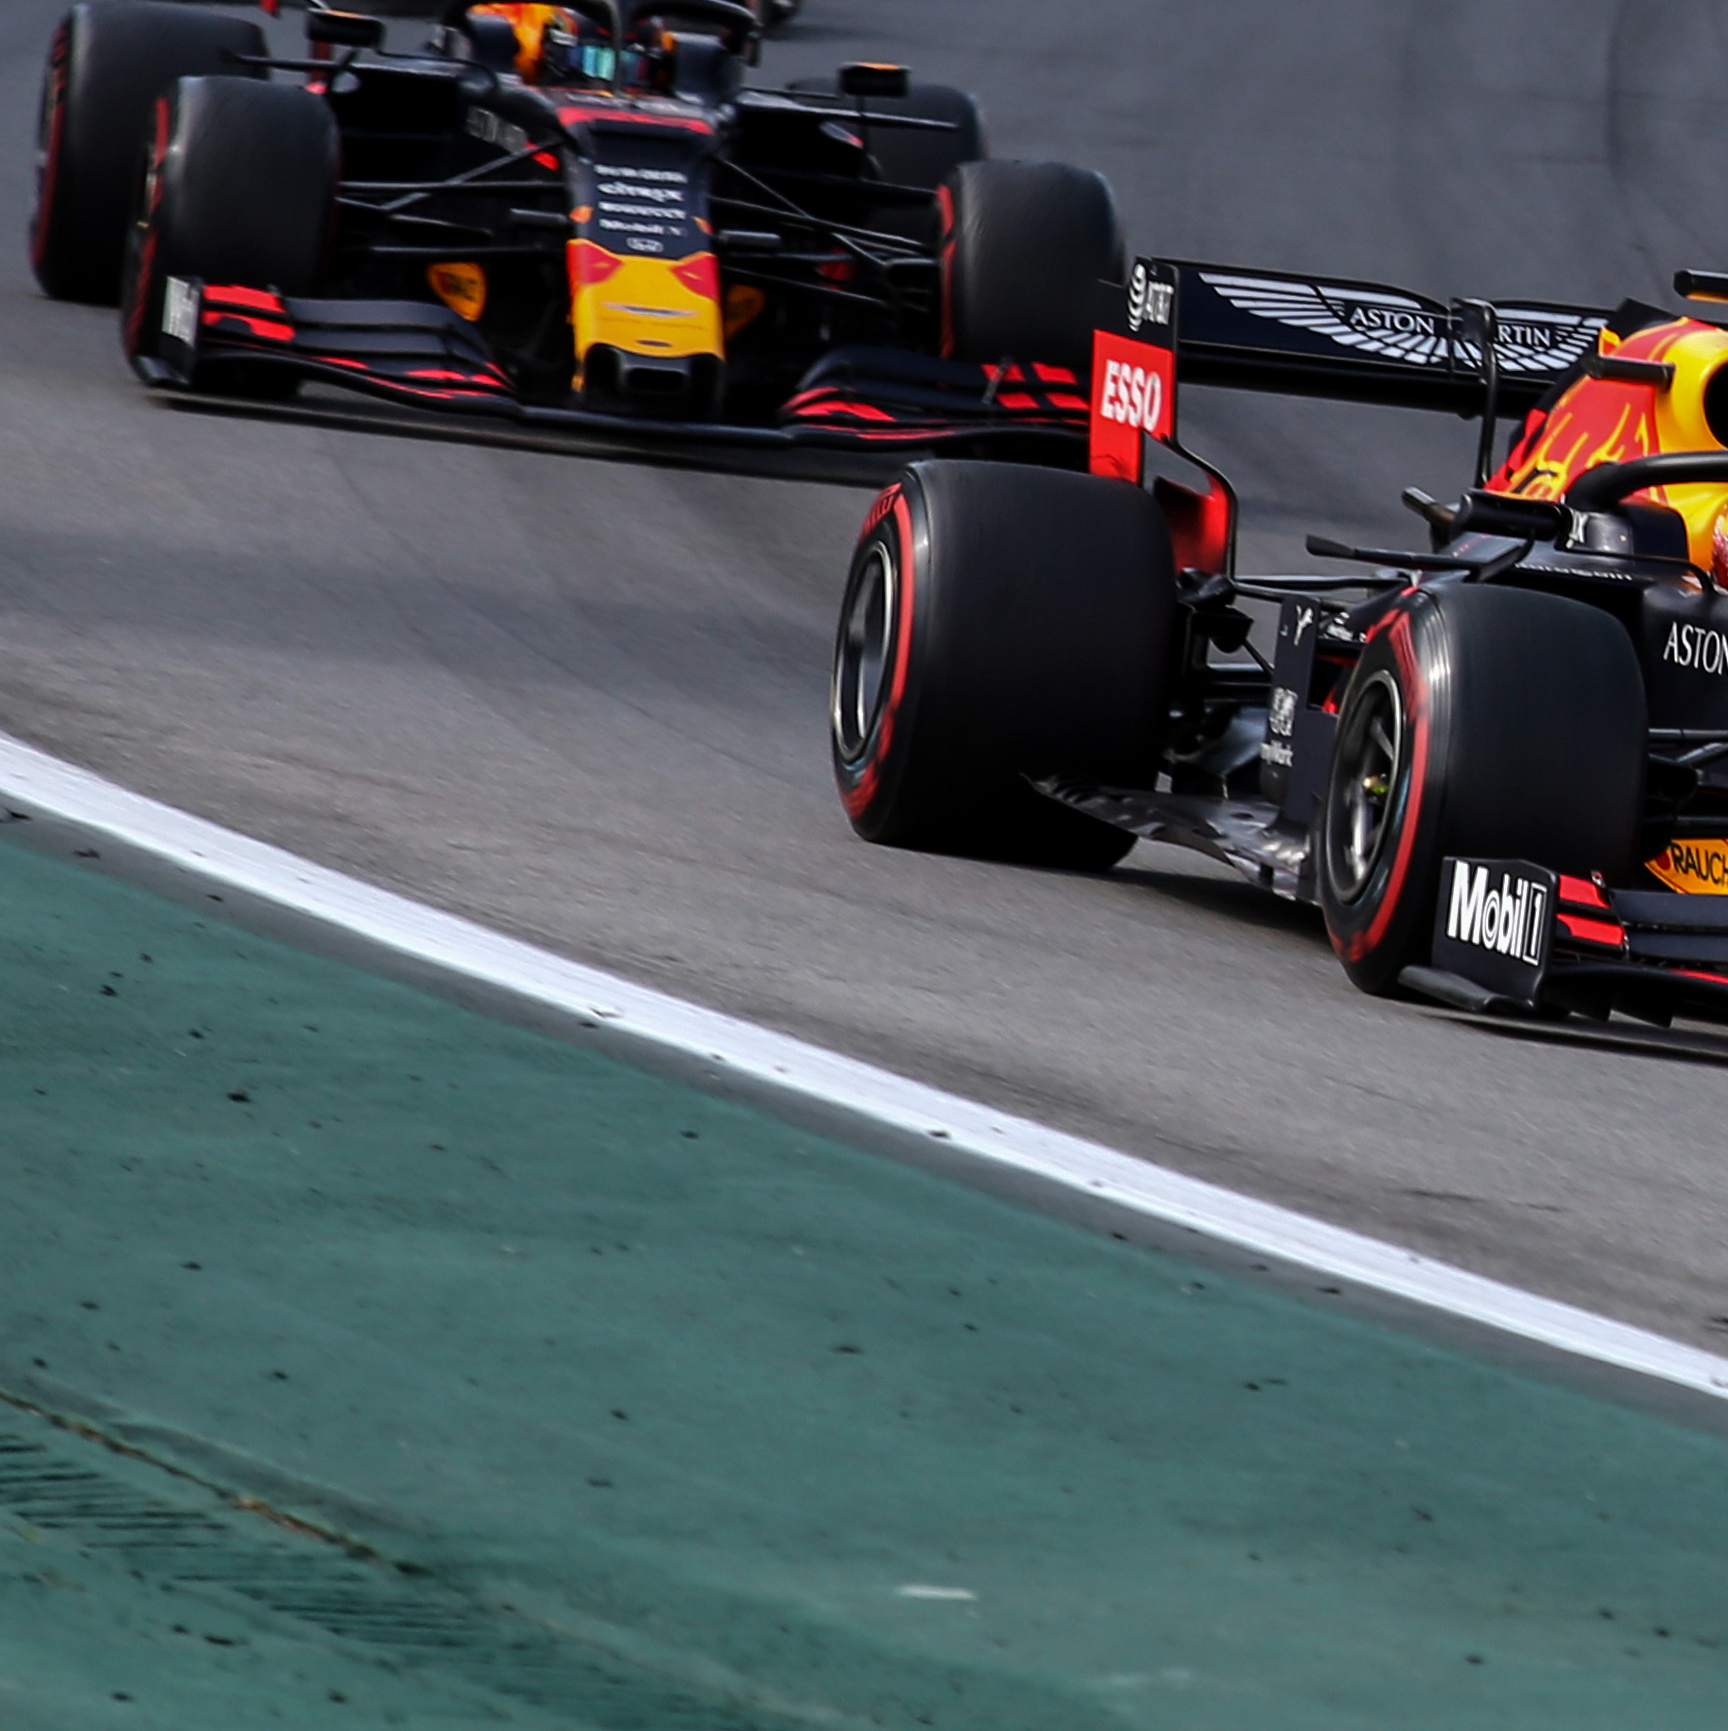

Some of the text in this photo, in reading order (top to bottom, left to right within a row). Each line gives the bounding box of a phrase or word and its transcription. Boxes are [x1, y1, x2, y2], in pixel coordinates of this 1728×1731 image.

[1350, 306, 1435, 335] ASTON
[1100, 358, 1162, 433] ESSO
[1447, 860, 1529, 959] Mobil
